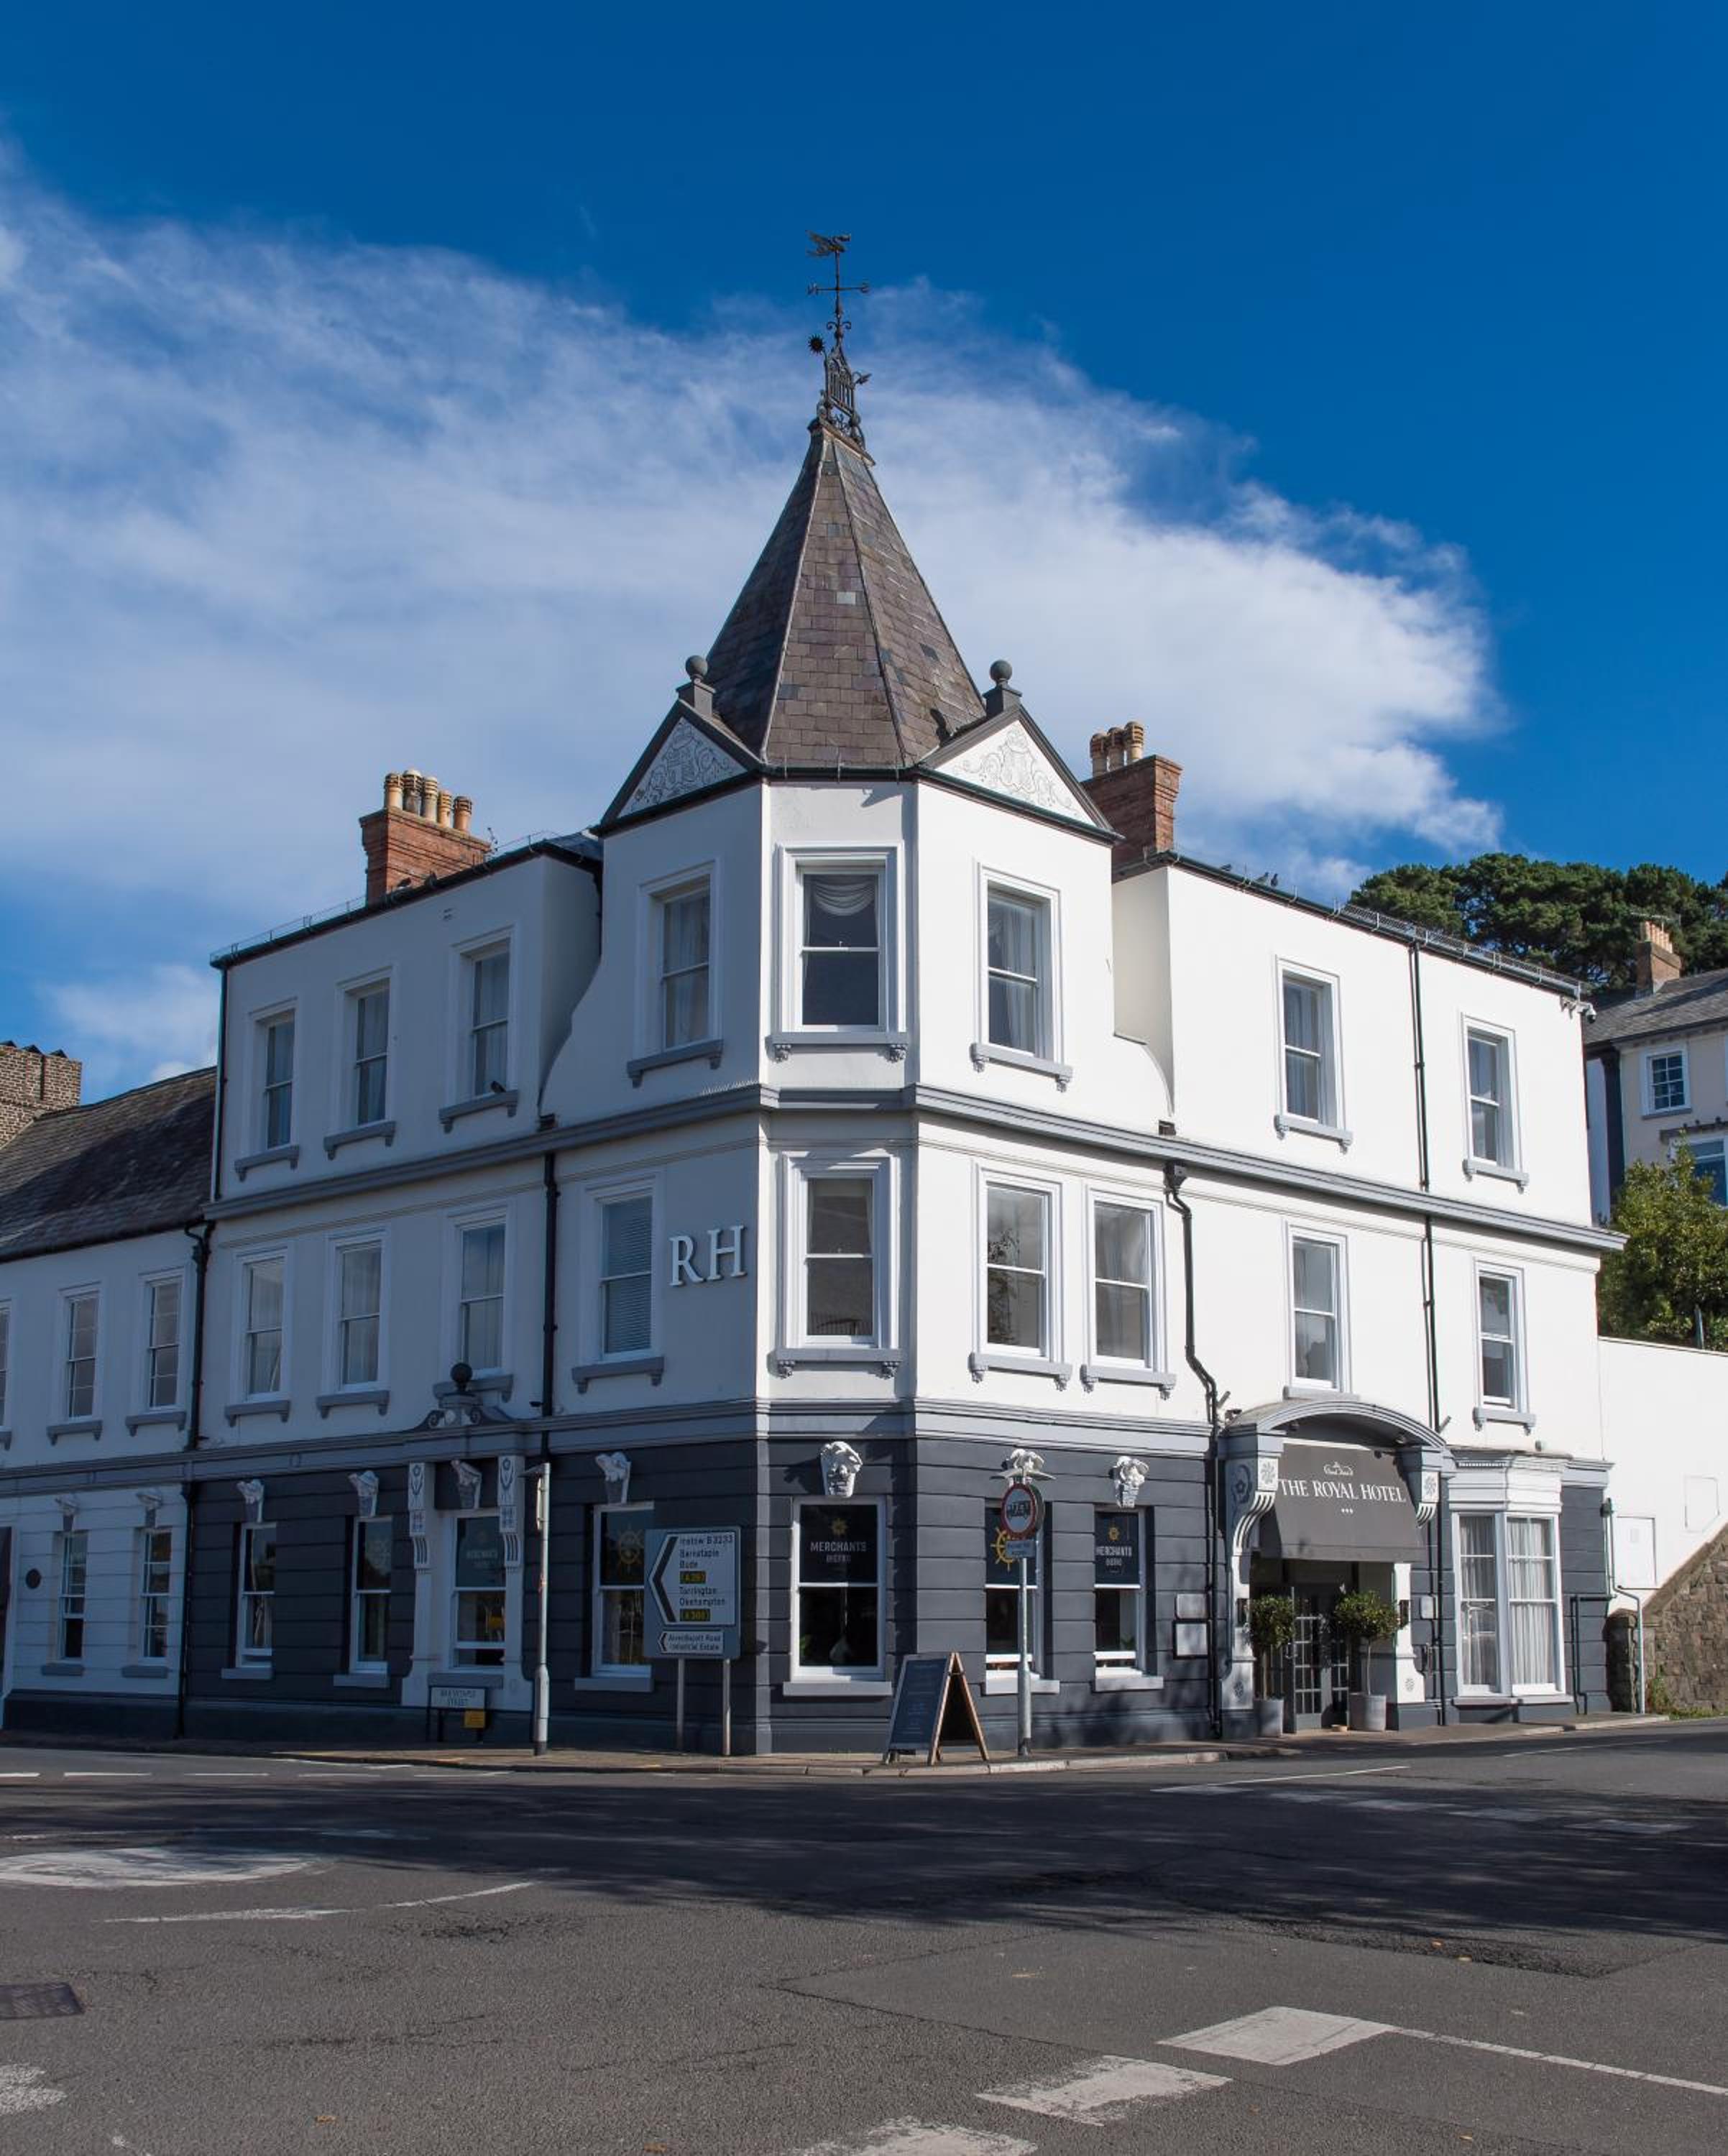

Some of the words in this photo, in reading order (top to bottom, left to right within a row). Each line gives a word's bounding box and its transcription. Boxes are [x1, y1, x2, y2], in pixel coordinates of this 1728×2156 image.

[668, 1225, 745, 1286] RH
[1277, 1478, 1309, 1497] THE
[1313, 1480, 1359, 1500] ROYAL
[1361, 1483, 1407, 1503] HOTEL
[810, 1541, 867, 1552] MERCHANTS
